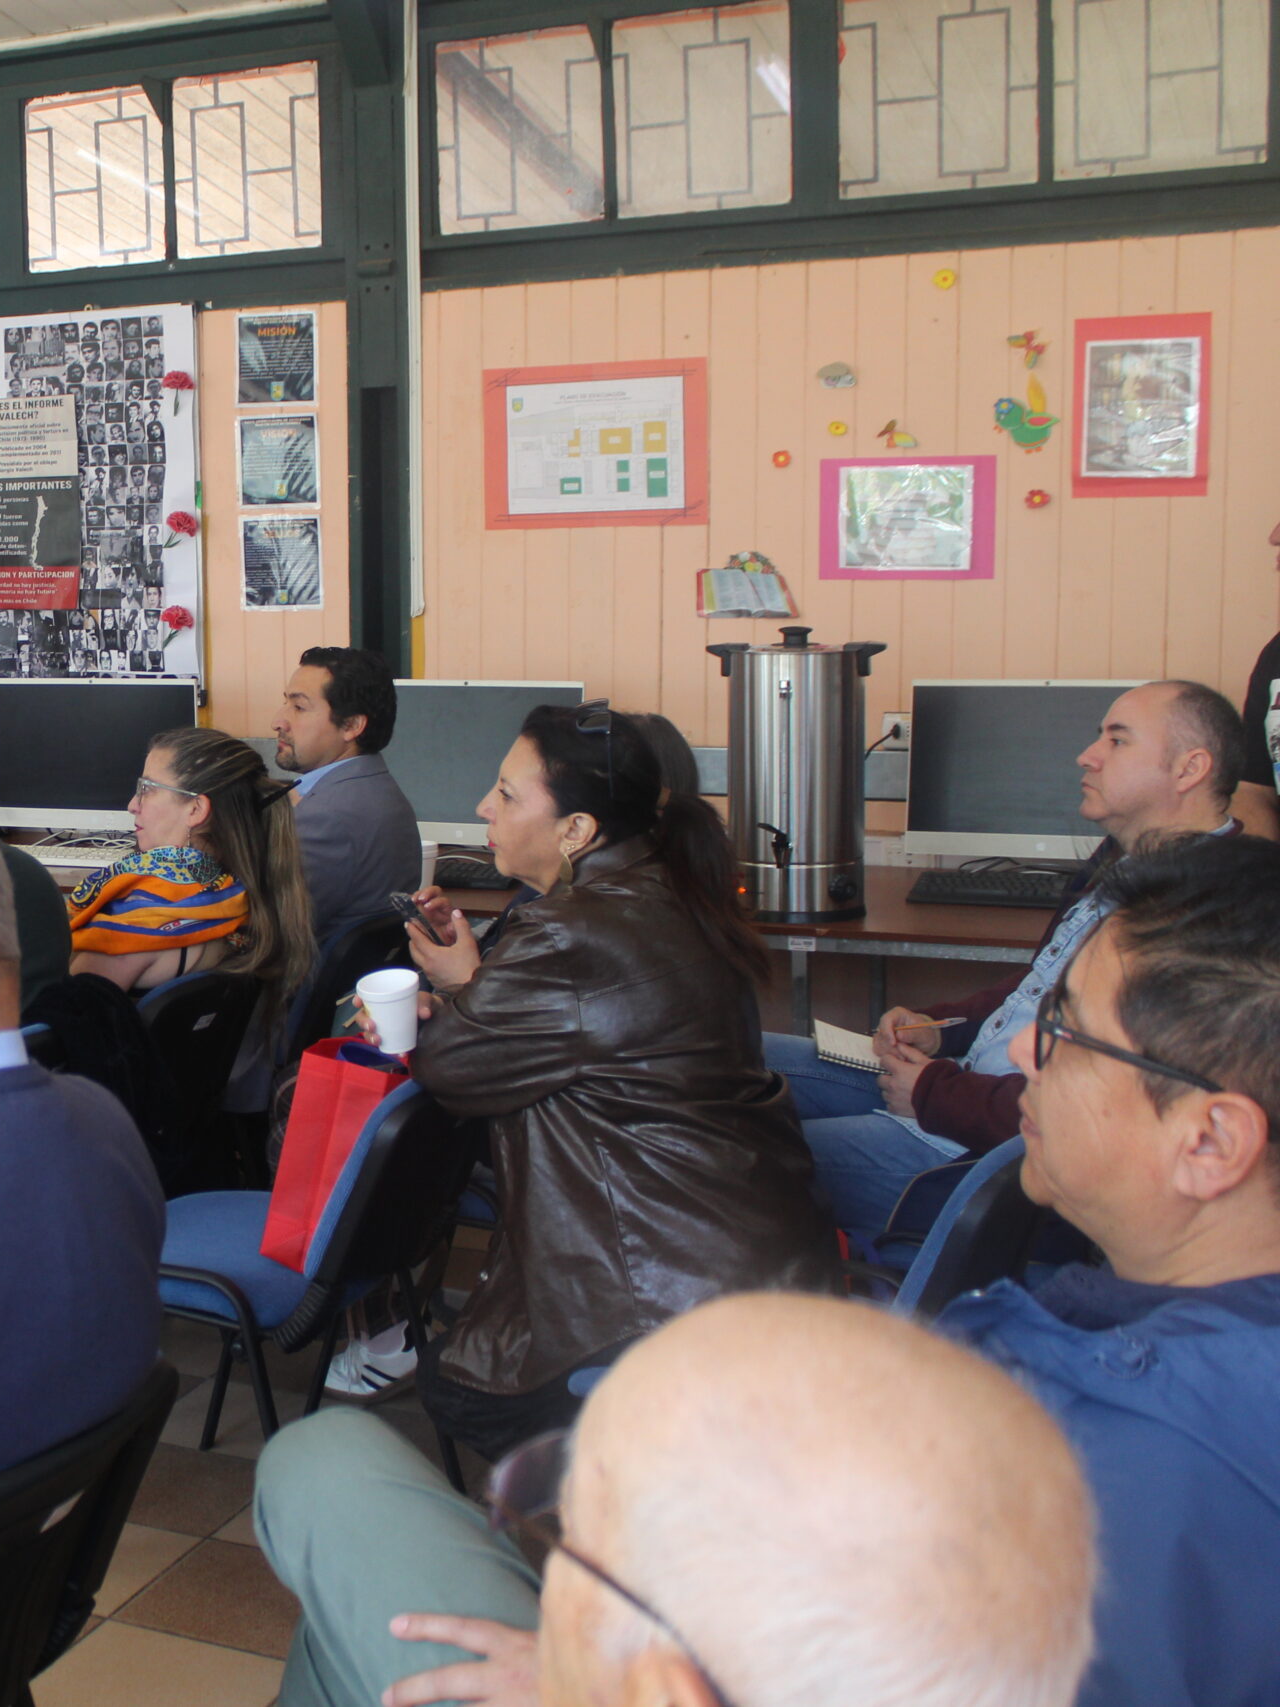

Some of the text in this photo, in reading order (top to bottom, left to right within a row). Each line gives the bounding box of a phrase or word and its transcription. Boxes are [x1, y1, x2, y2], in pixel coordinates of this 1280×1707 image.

[258, 325, 296, 336] MISIÓN
[0, 402, 9, 410] ES
[13, 401, 22, 410] EL
[25, 399, 64, 409] INFORME
[0, 411, 38, 420] VALECH?
[5, 481, 72, 491] IMPORTANTES
